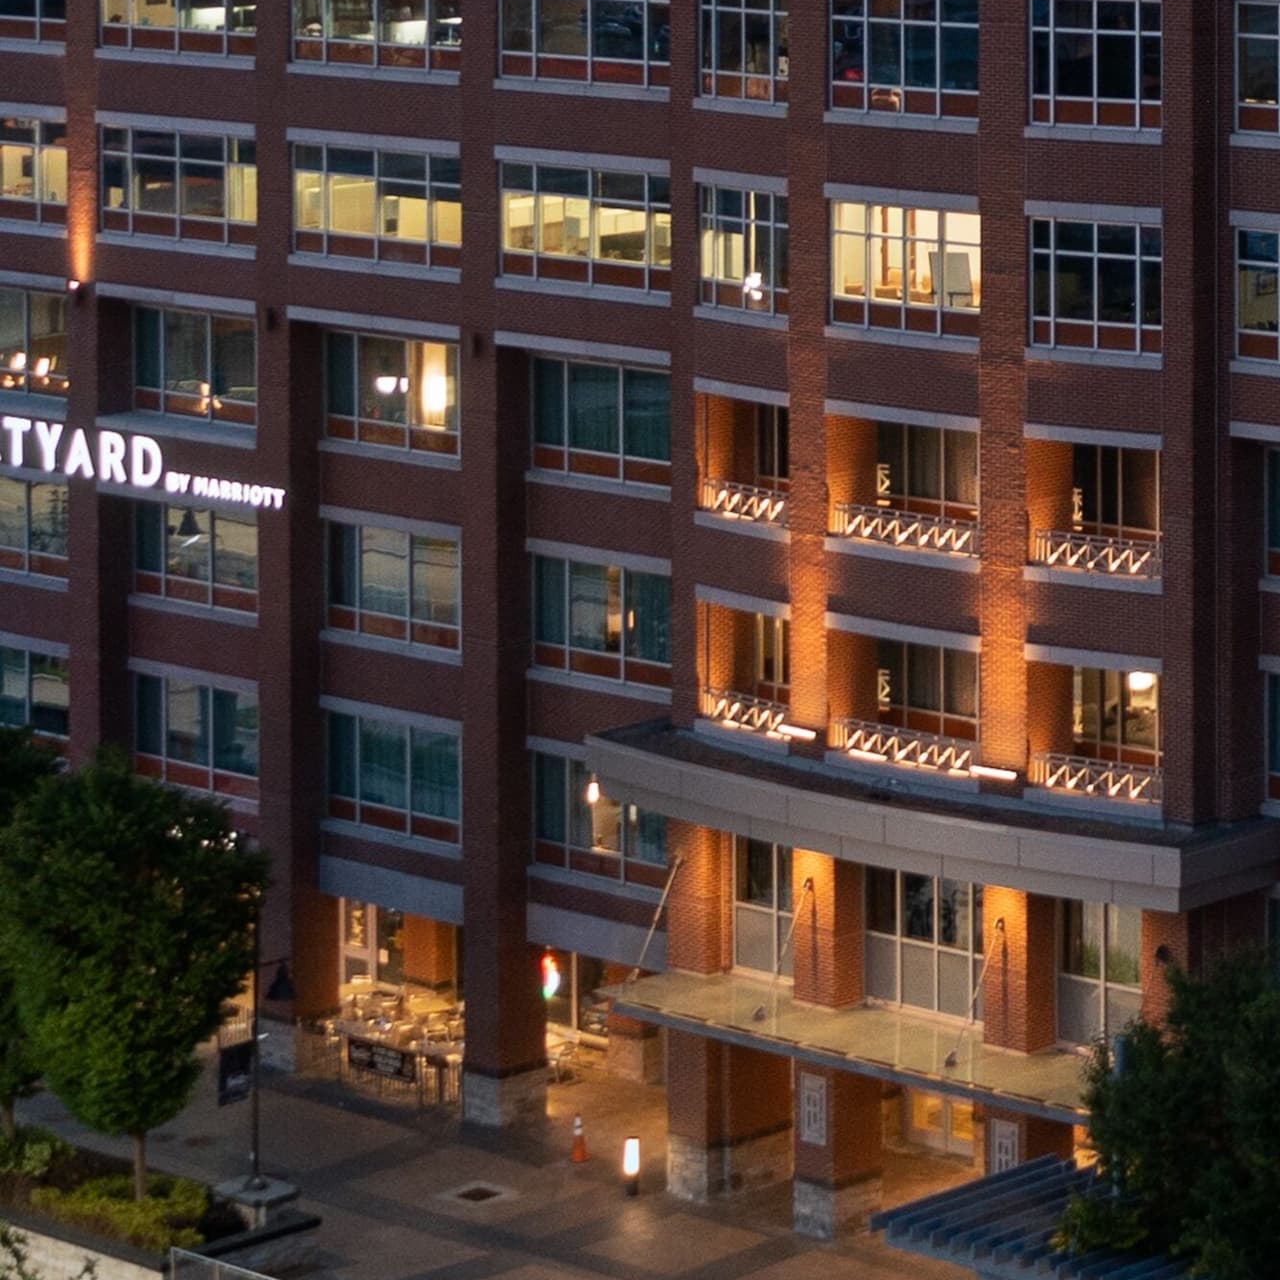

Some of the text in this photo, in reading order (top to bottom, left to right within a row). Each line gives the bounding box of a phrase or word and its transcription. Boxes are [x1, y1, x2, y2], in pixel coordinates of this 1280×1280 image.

[0, 414, 286, 510] TYARD BY MARRIOTT
